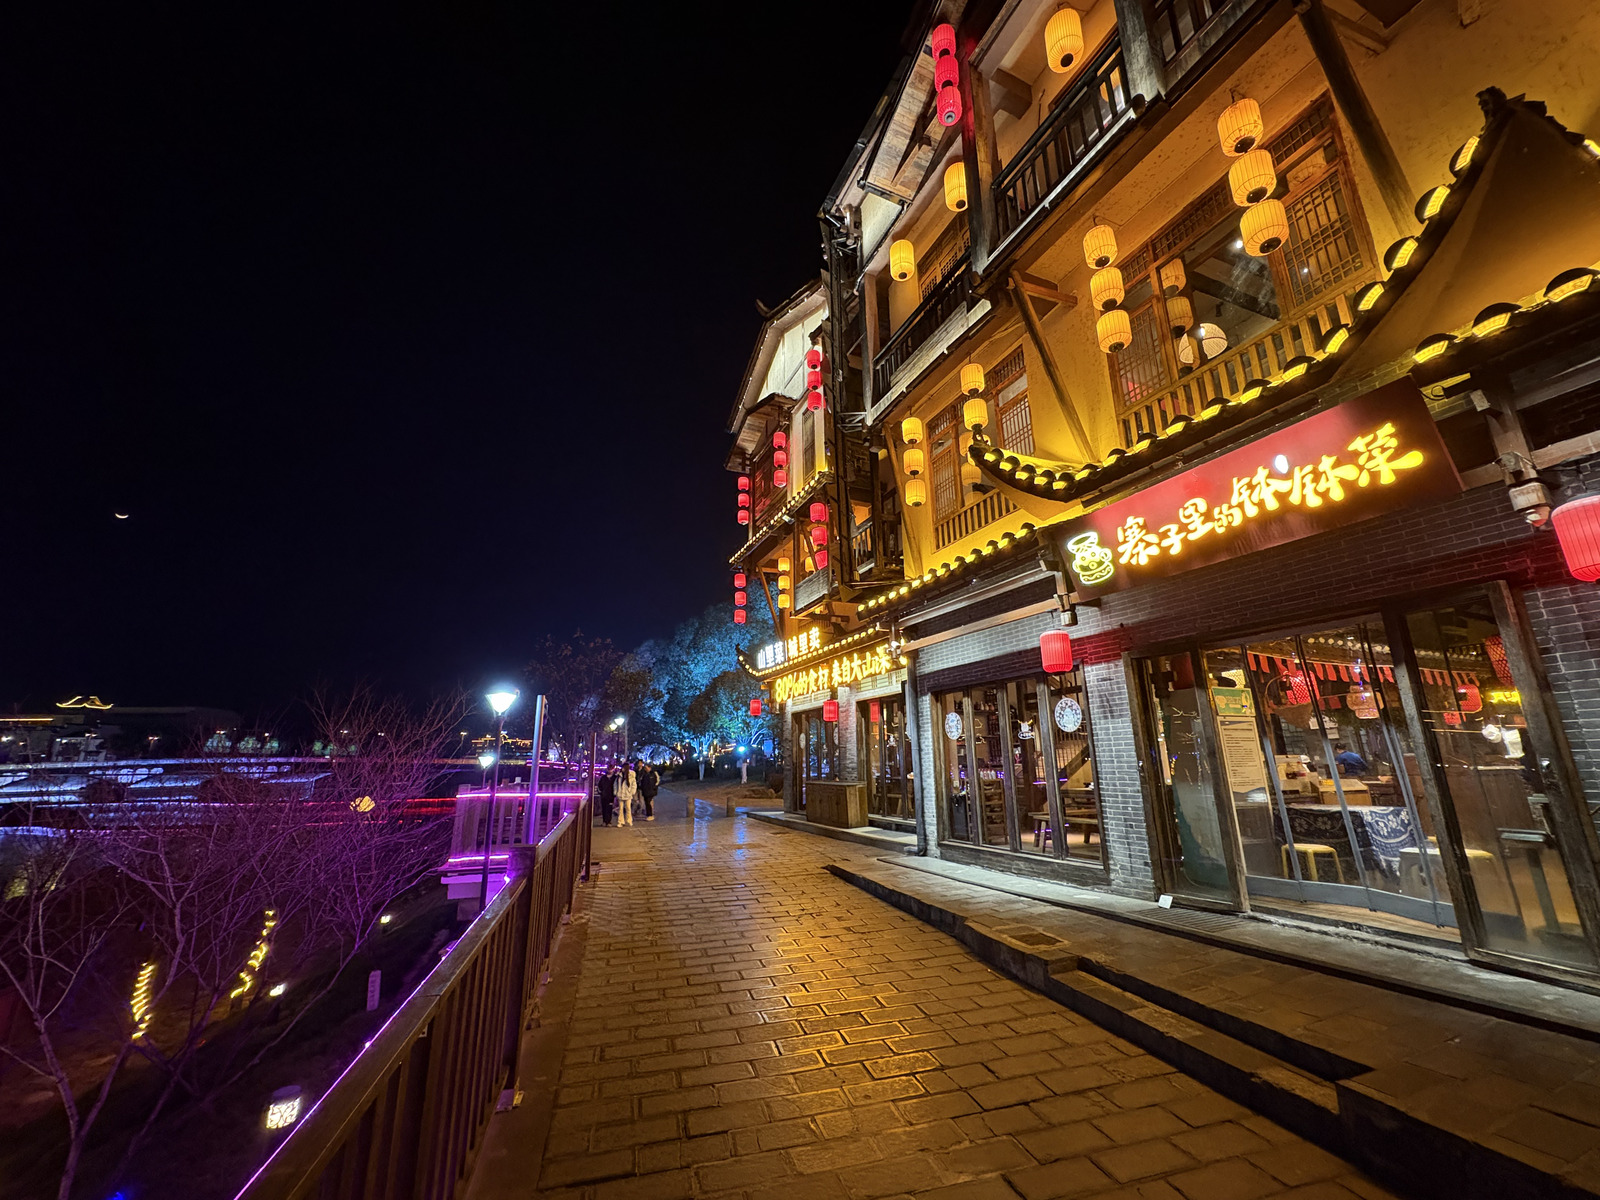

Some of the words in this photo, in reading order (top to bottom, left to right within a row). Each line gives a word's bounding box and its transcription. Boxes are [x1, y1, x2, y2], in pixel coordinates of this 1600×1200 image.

[1116, 422, 1424, 566] 寨子里的钵钵菜
